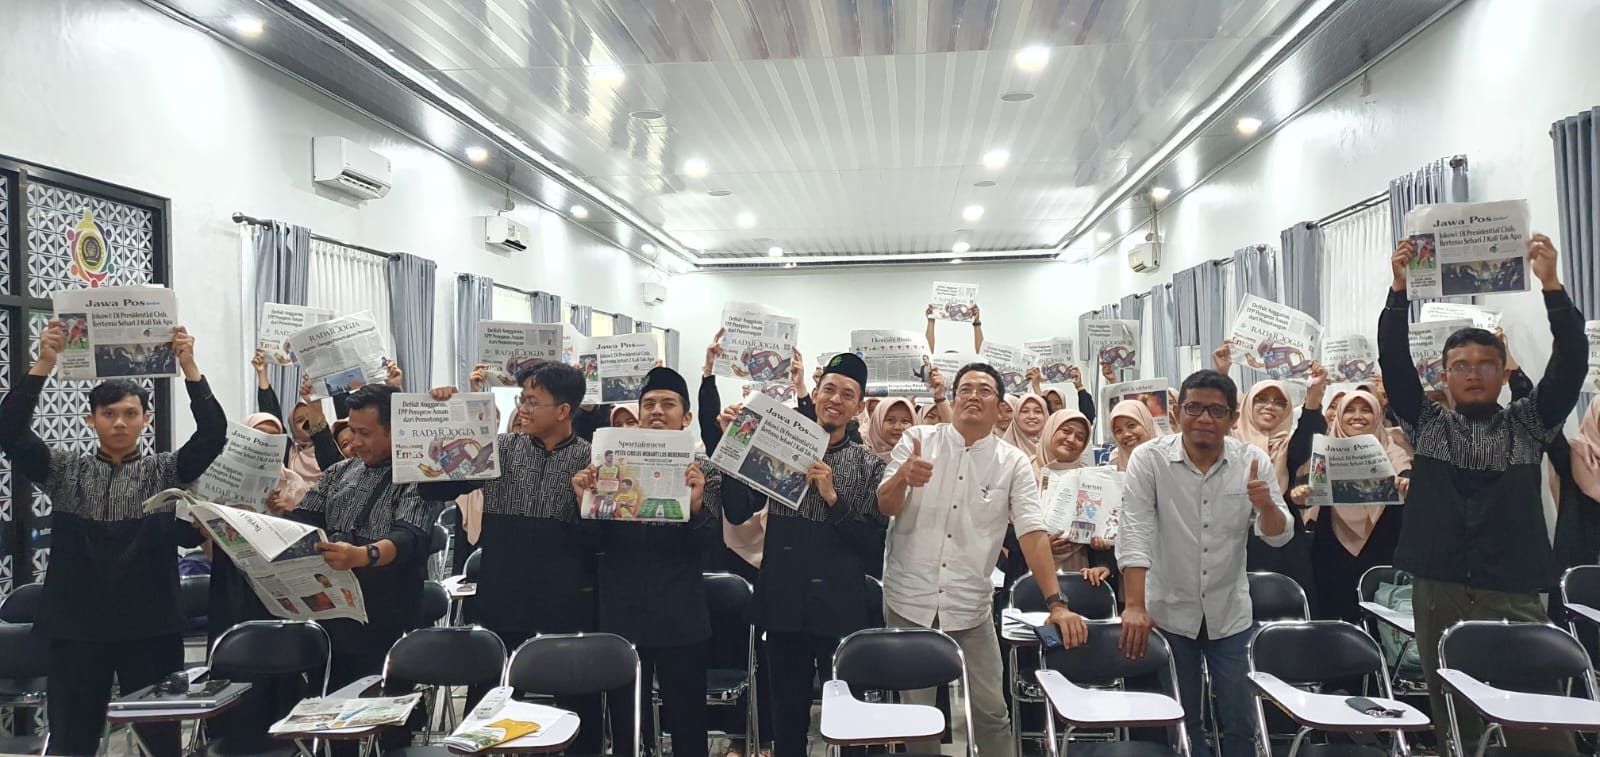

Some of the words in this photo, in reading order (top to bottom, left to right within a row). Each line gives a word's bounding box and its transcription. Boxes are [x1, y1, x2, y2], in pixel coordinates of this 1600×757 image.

[1467, 227, 1500, 236] Presidential
[1464, 236, 1481, 245] Sehari
[1251, 326, 1279, 340] RADAR
[766, 407, 790, 424] Jawa
[793, 421, 809, 435] Pos
[412, 428, 444, 437] RADAR
[446, 428, 475, 436] JOGJA
[232, 430, 251, 441] Jawa
[253, 437, 268, 447] Pos
